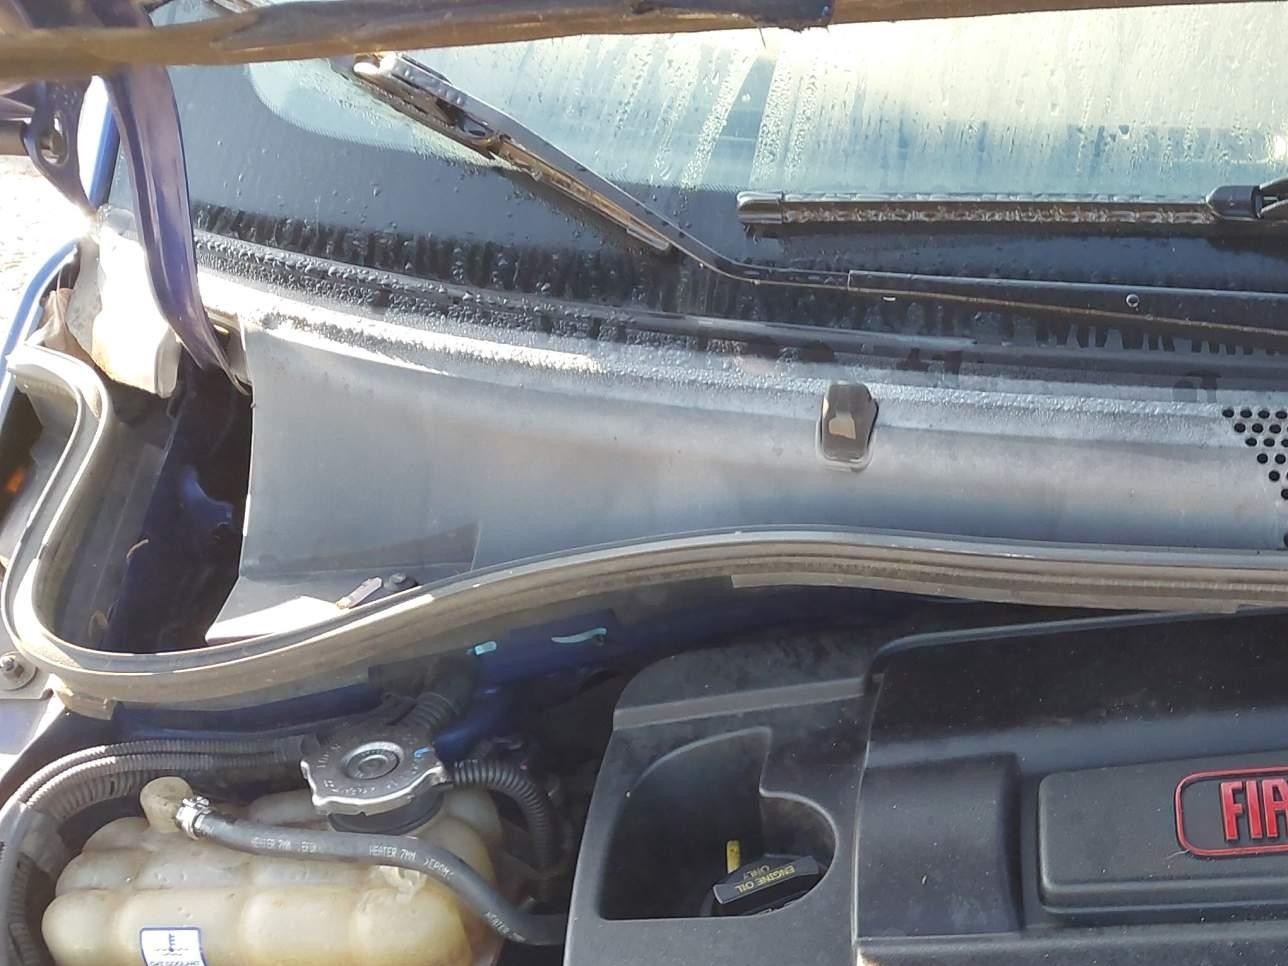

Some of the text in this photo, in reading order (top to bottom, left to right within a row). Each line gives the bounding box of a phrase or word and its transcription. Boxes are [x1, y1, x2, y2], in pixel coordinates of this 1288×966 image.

[369, 844, 398, 859] HEATER
[735, 864, 797, 893] ENGINE OIL
